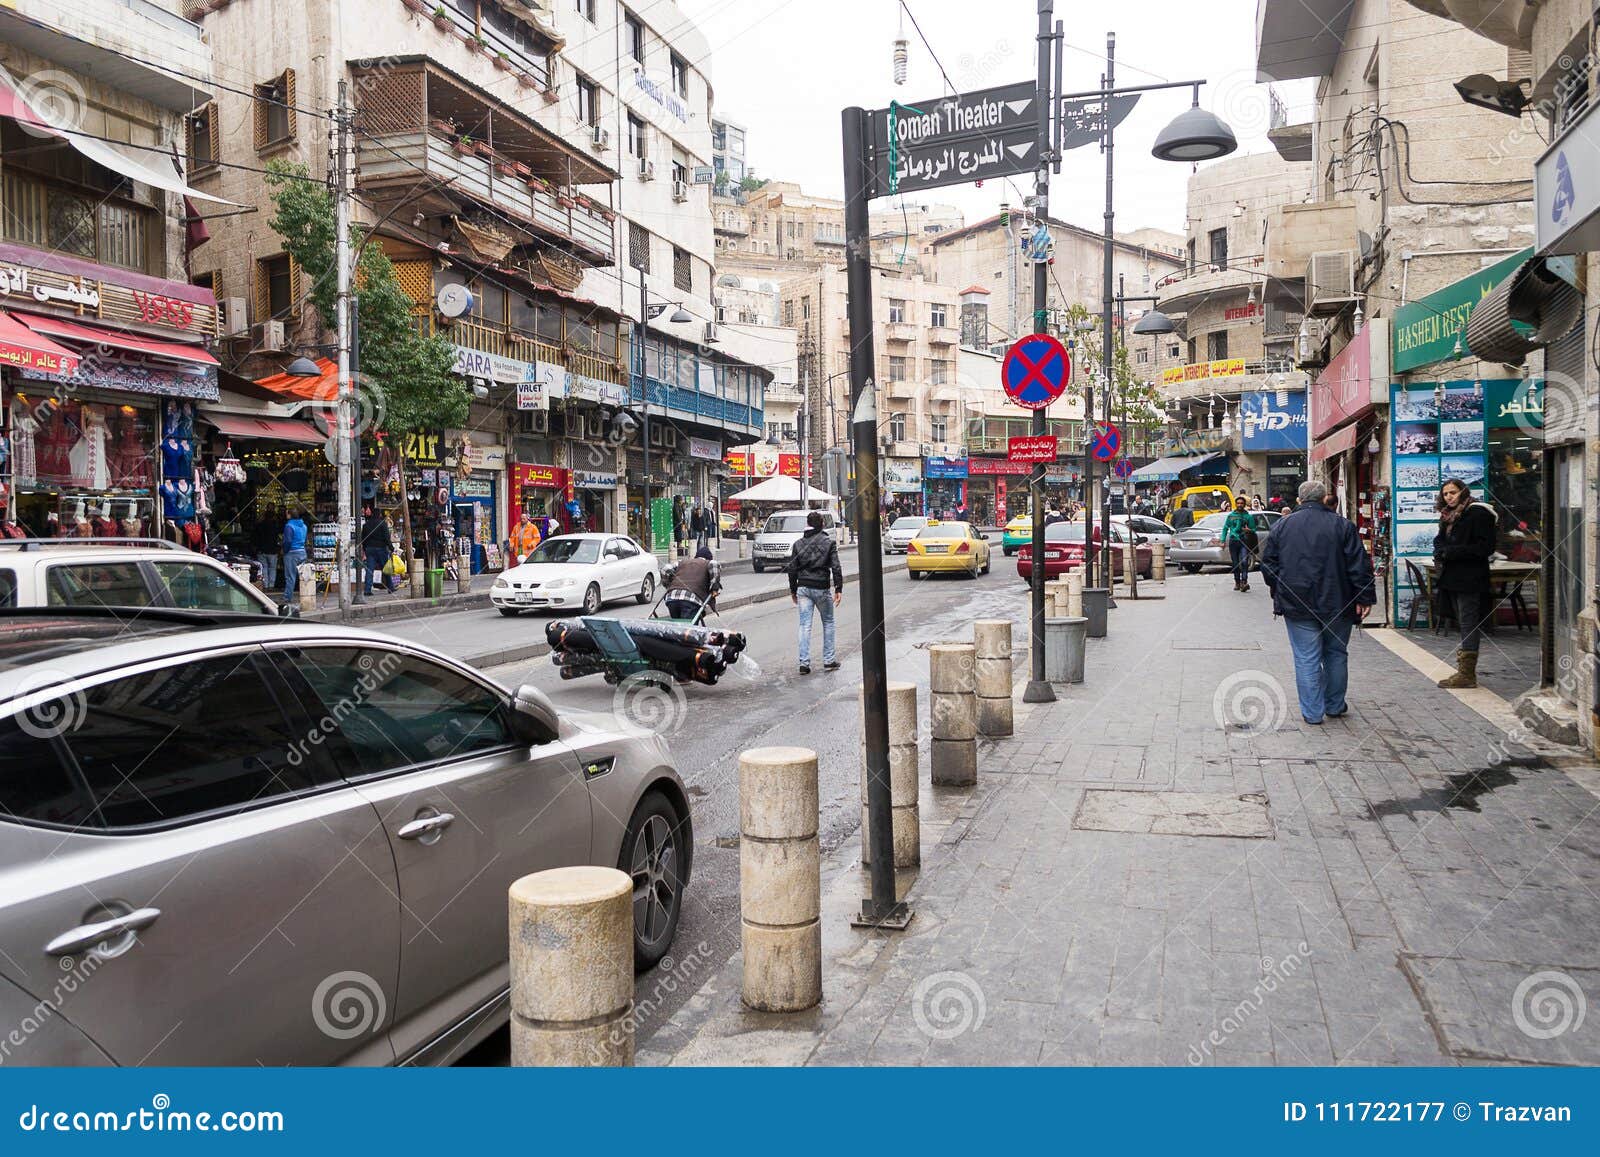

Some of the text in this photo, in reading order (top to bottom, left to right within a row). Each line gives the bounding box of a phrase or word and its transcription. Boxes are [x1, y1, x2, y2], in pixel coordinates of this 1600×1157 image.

[944, 97, 1004, 131] Theater
[890, 140, 1004, 187] المدرج الروماني
[1398, 313, 1440, 353] HASHEM
[37, 354, 57, 369] عالم
[458, 351, 492, 374] SARA
[1184, 364, 1210, 380] INTERNET CAFE
[518, 384, 542, 393] VALET
[528, 469, 553, 480] كنوز
[598, 475, 616, 485] محمد
